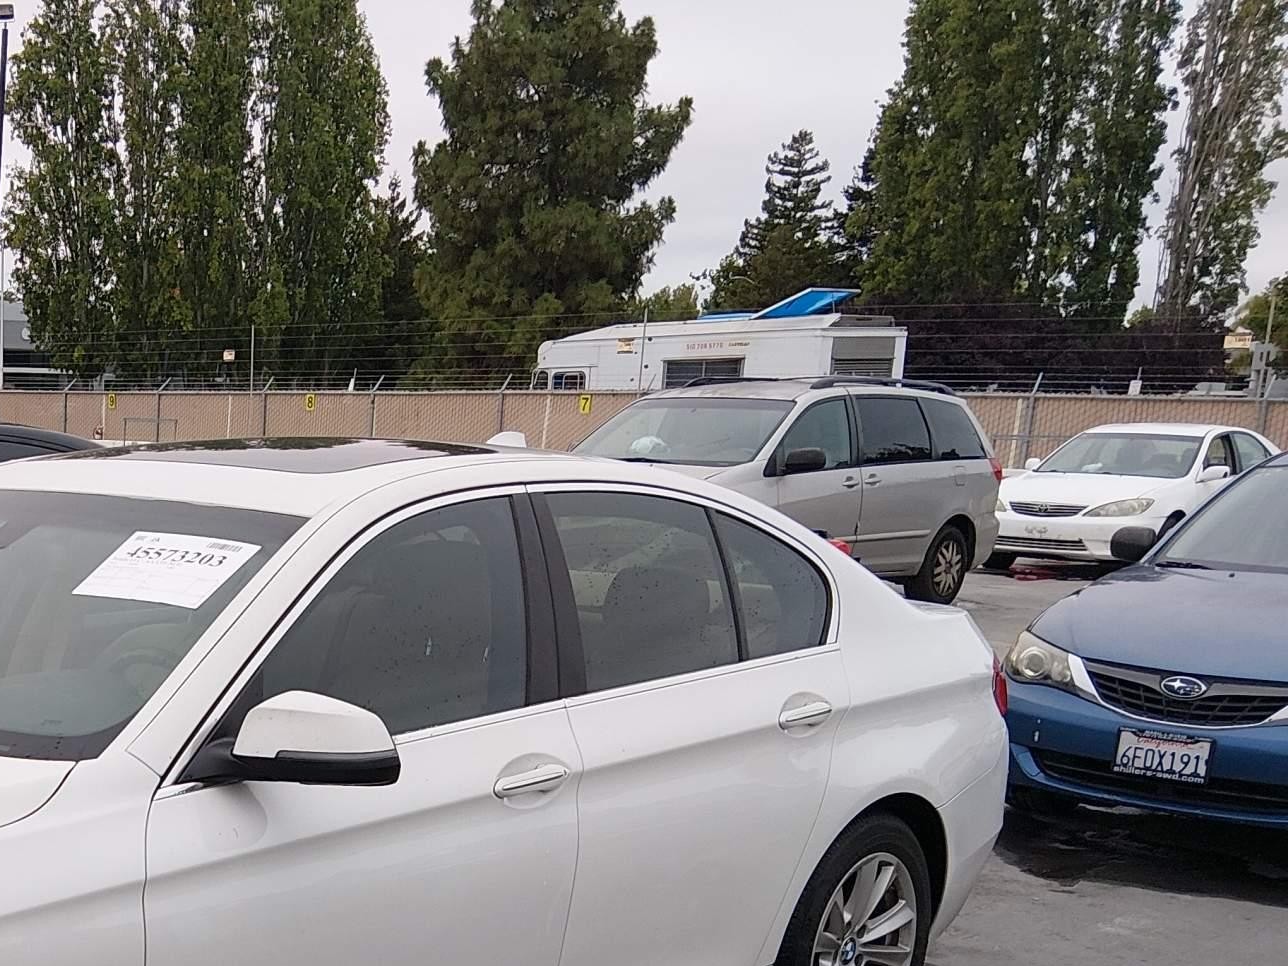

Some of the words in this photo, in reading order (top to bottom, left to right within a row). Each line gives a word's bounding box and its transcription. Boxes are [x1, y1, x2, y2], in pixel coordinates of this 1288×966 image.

[109, 395, 115, 407] 9
[307, 396, 313, 409] 8
[581, 396, 590, 411] 7
[126, 546, 228, 568] 45573203
